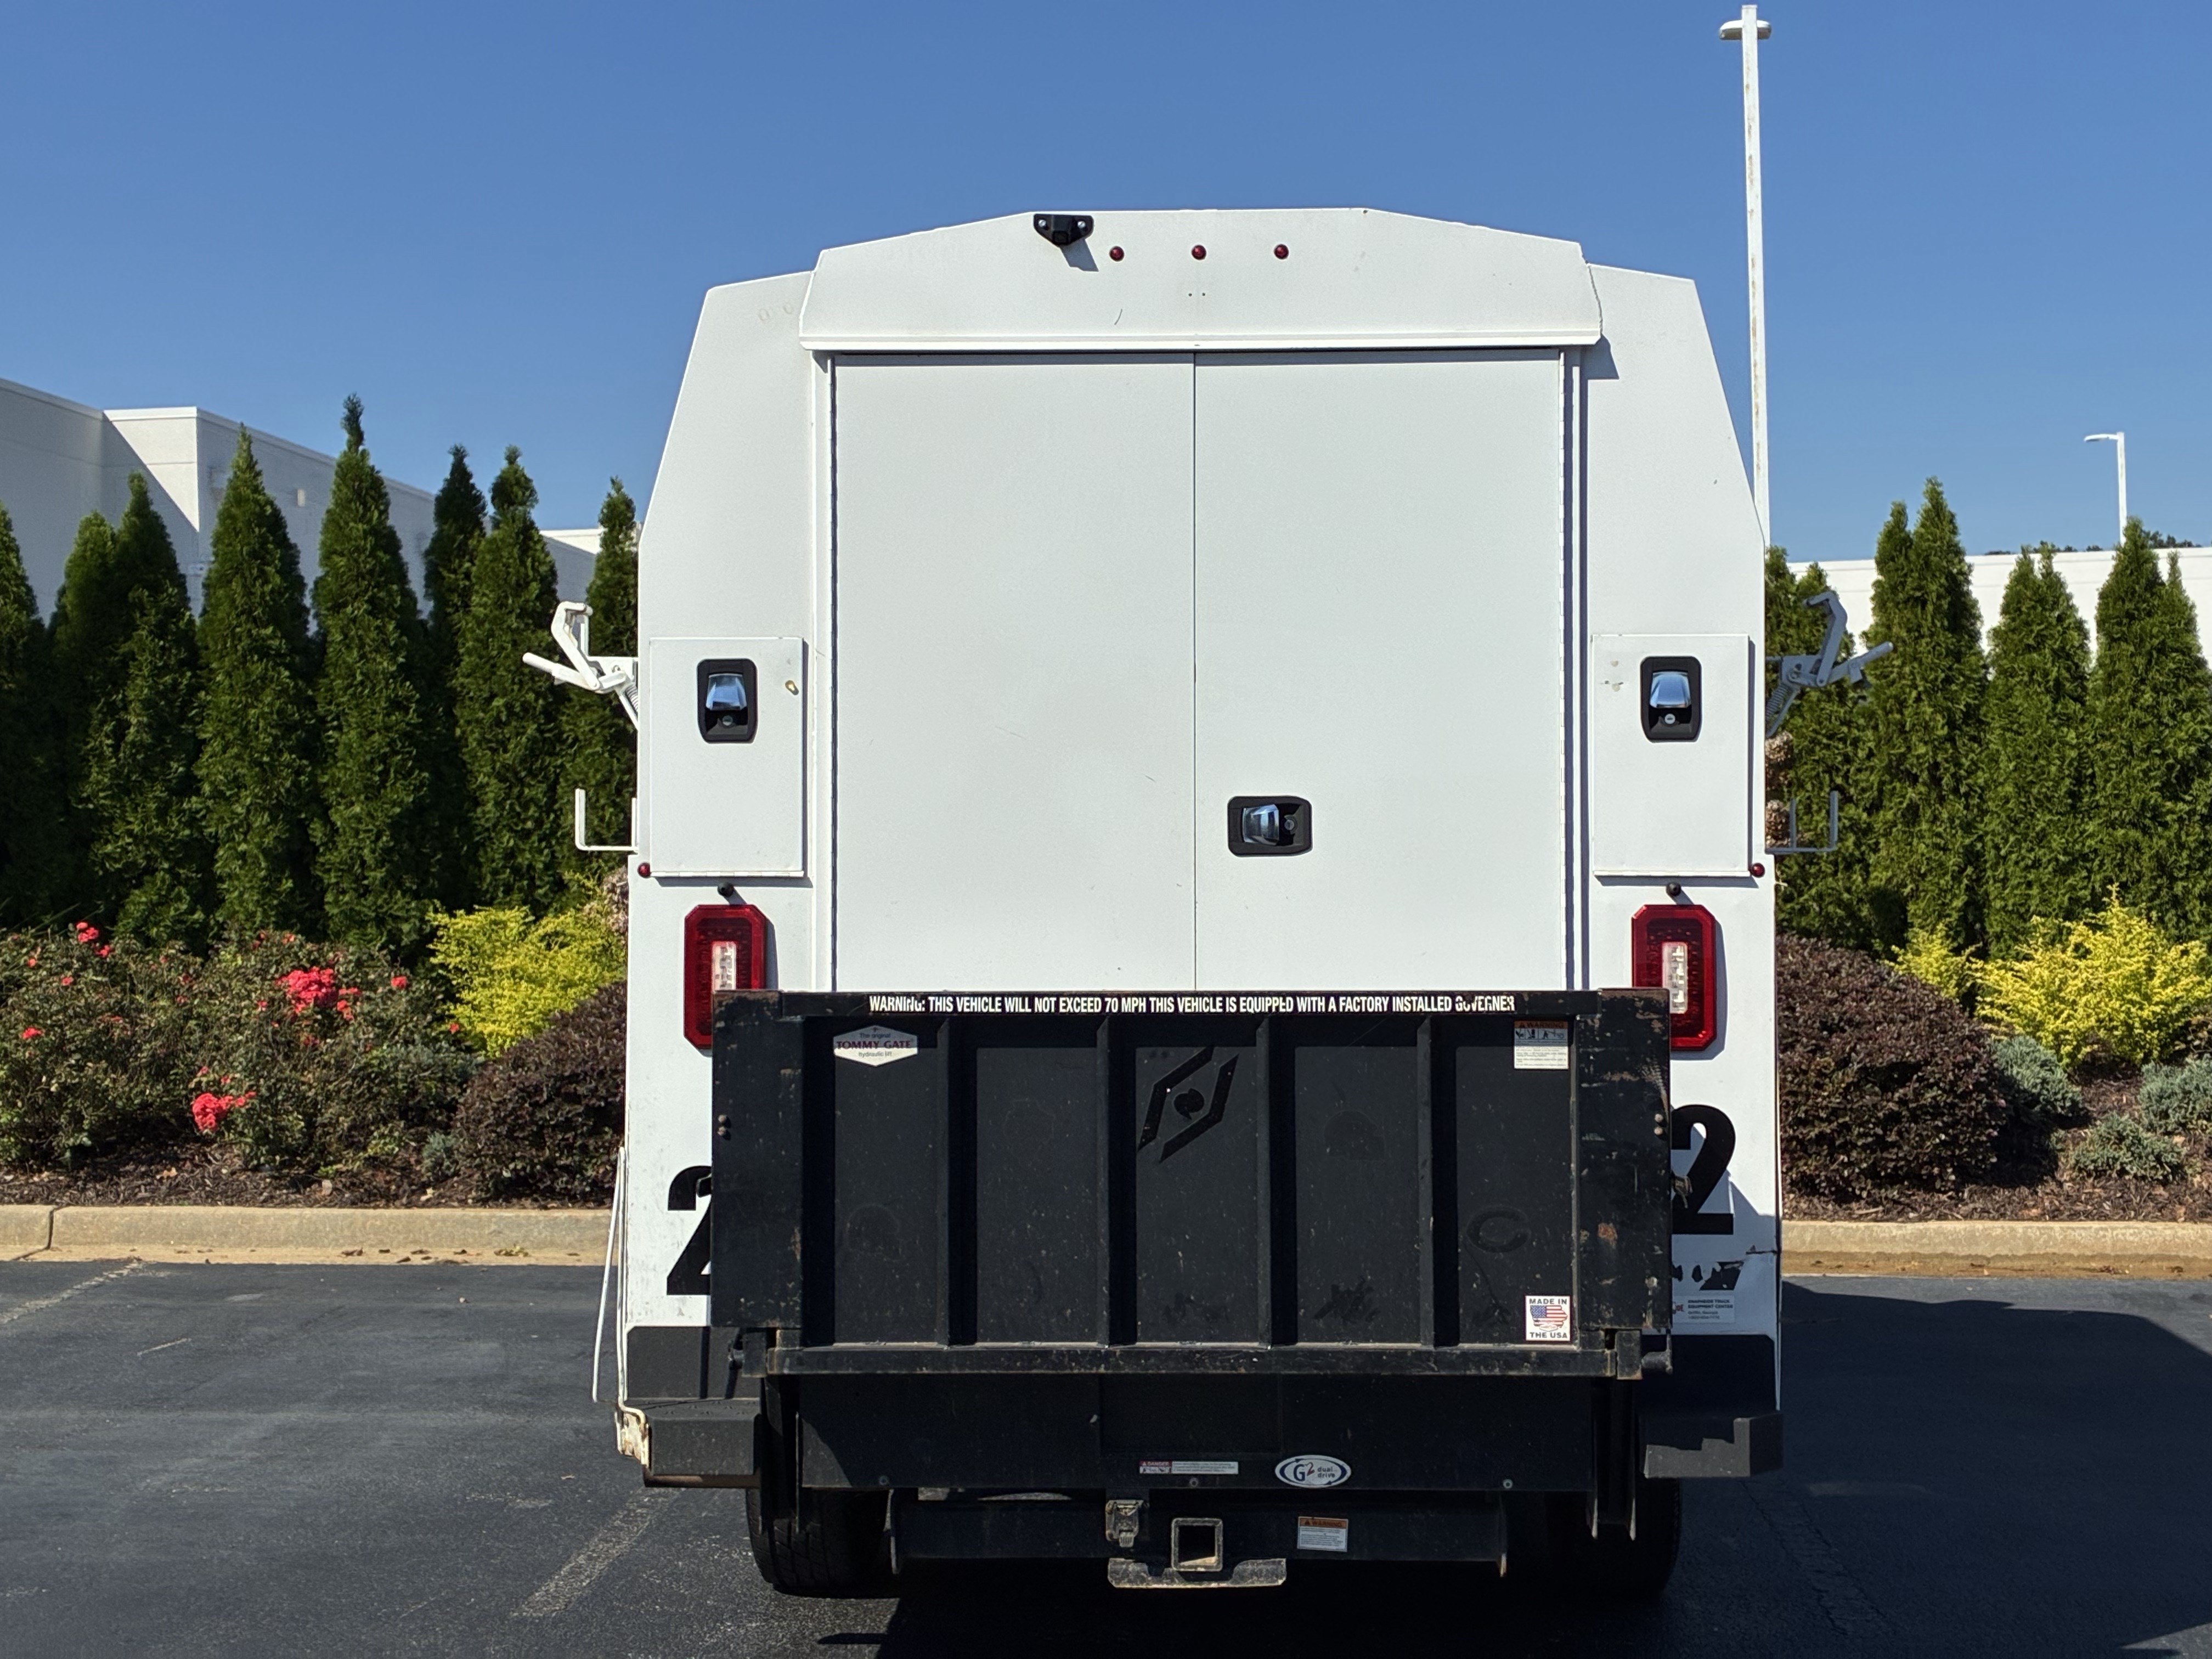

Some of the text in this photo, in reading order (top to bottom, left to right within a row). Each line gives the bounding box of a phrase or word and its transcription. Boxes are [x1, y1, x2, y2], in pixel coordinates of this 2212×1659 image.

[869, 996, 926, 1012] WARNING:
[928, 997, 953, 1012] THIS
[956, 997, 1002, 1012] VEHICLE
[1005, 997, 1032, 1012] WILL
[1035, 997, 1057, 1012] NOT
[1059, 997, 1102, 1012] EXCEED
[1105, 997, 1118, 1012] 70
[1121, 997, 1146, 1012] MPH
[1149, 997, 1175, 1012] THIS
[1177, 997, 1223, 1012] VEHICLE
[1226, 997, 1237, 1012] IS
[1239, 997, 1294, 1013] EQUIPPED
[1296, 996, 1325, 1012] WITH
[1328, 996, 1337, 1012] A
[1339, 996, 1390, 1012] FACTORY
[1392, 996, 1452, 1012] INSTALLED
[837, 1040, 911, 1048] TOMMY GATE
[1671, 1104, 1736, 1235] 2
